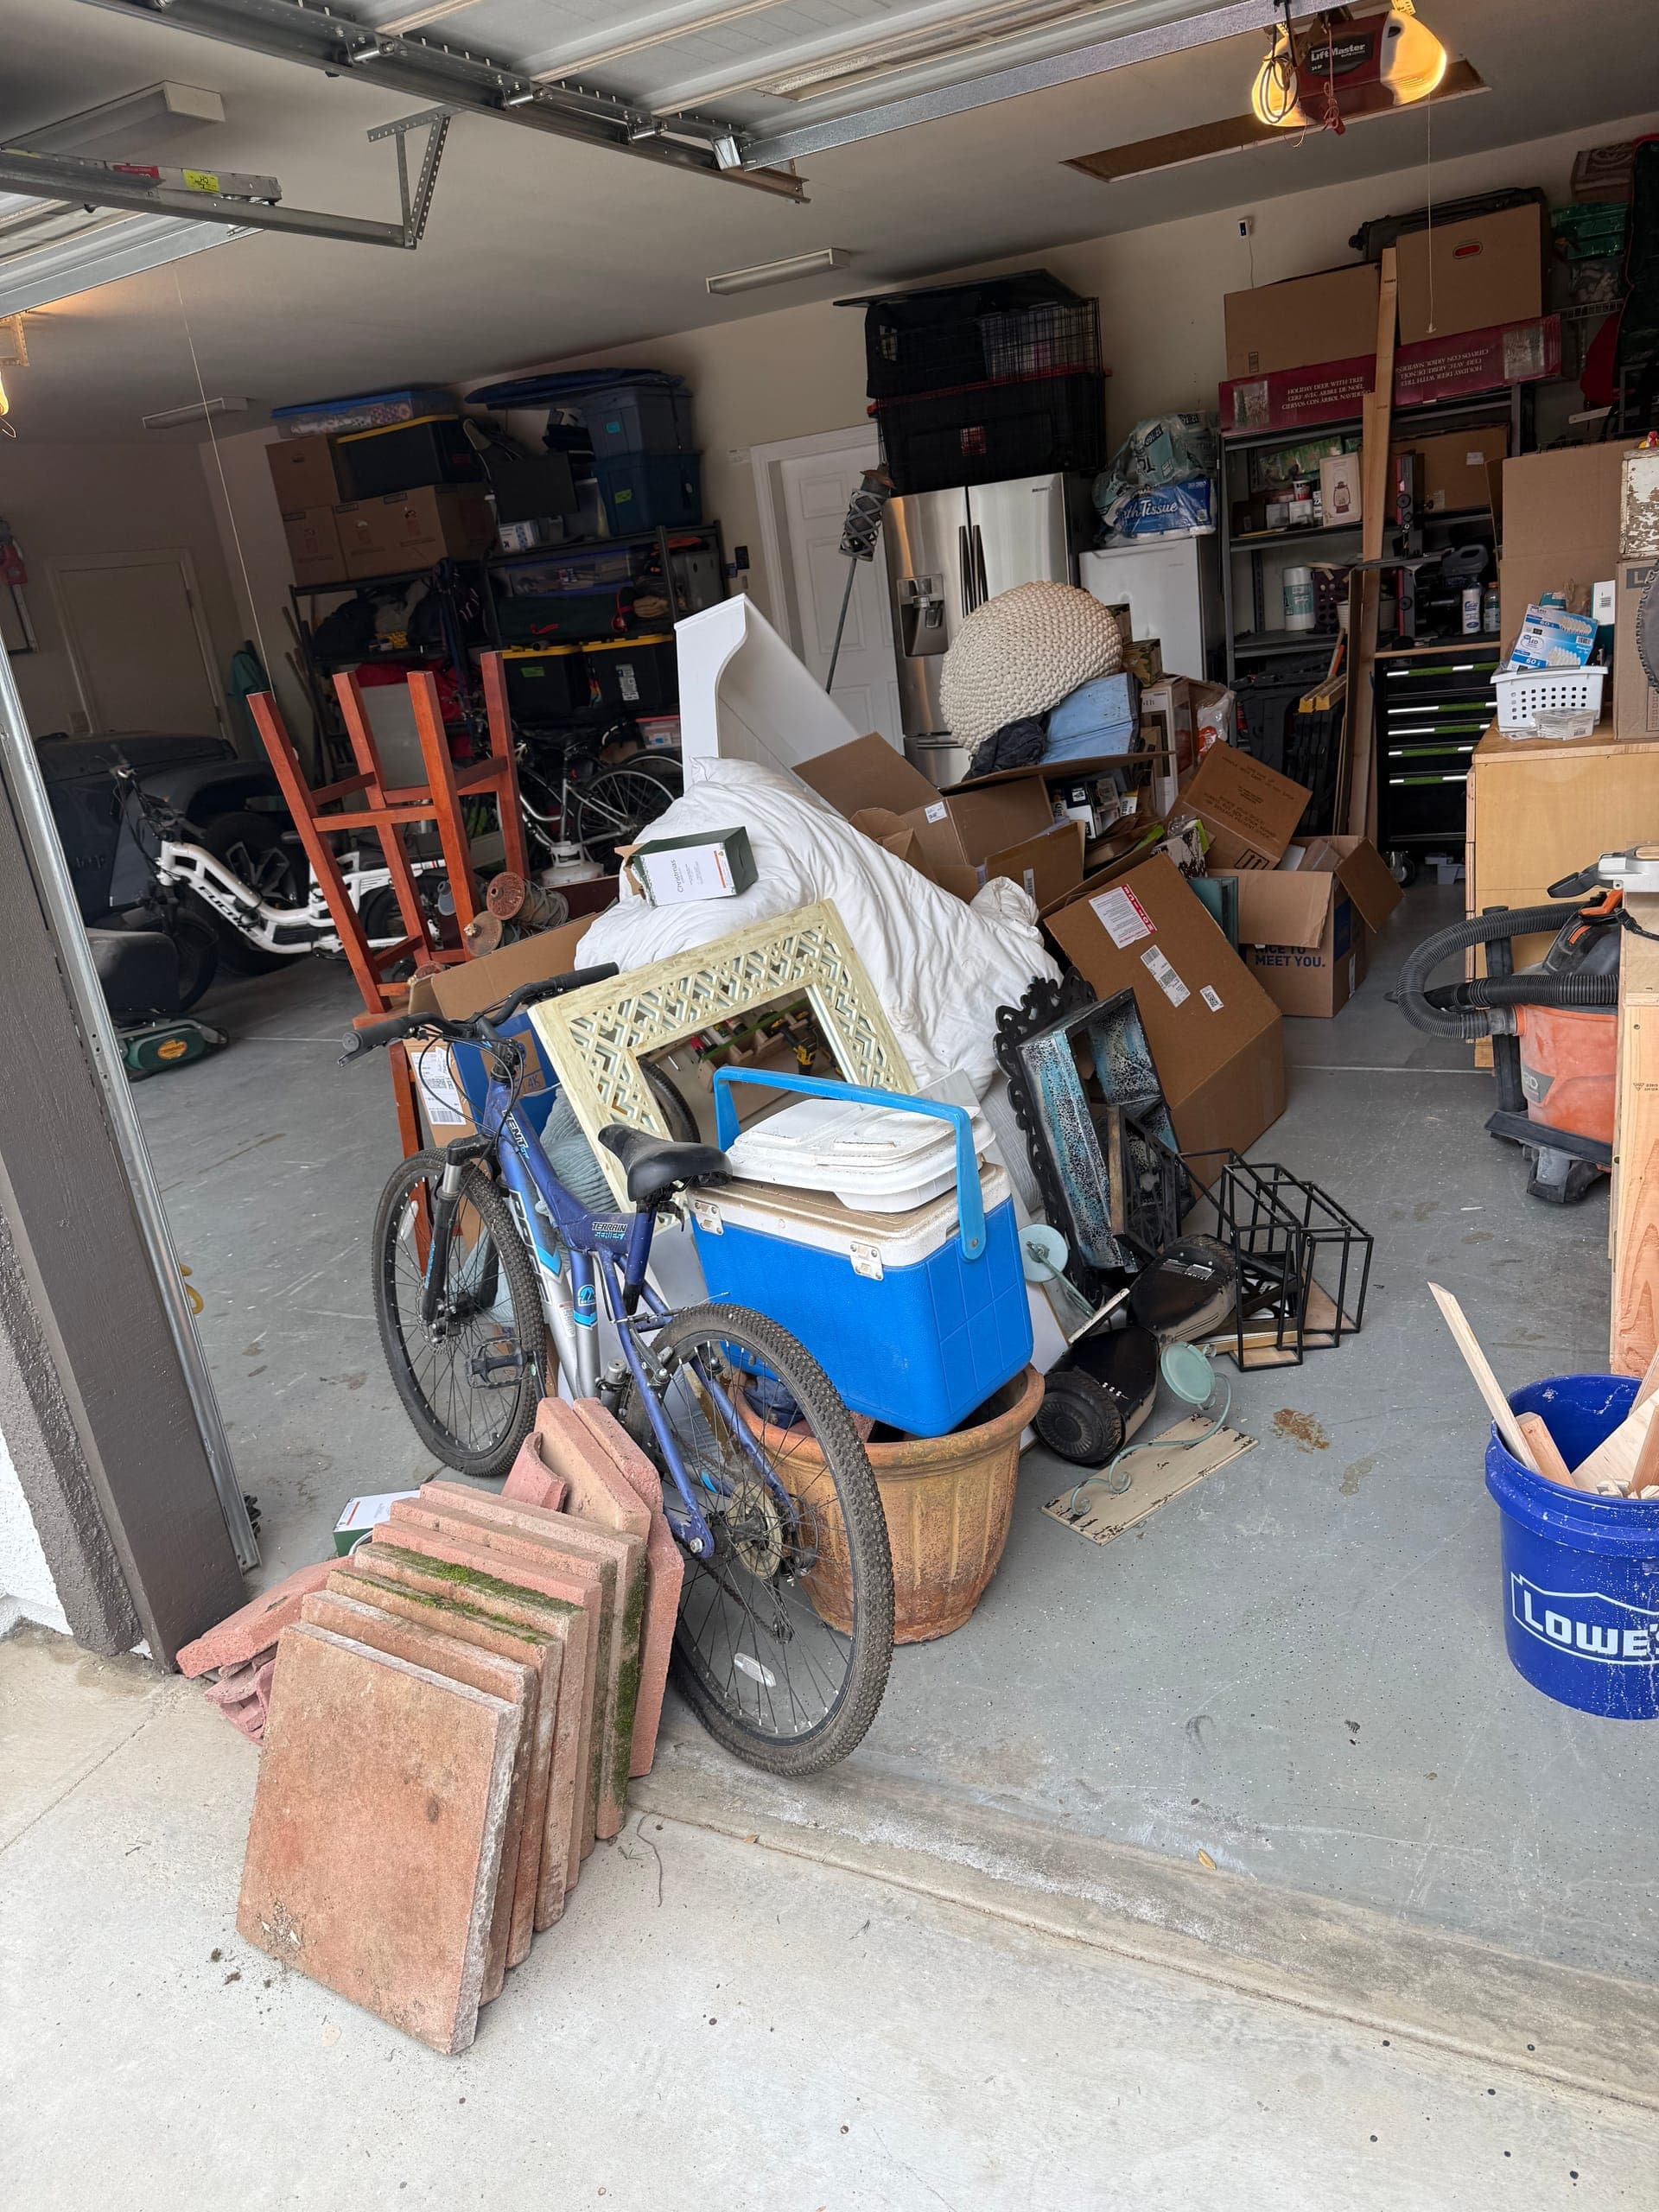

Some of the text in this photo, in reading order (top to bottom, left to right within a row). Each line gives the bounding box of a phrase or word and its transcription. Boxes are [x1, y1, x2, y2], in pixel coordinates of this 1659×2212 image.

[1140, 499, 1178, 518] Tissue
[671, 859, 683, 893] Christmas
[1255, 955, 1326, 967] MEET YOU.
[591, 1222, 628, 1232] TERRAIN
[1523, 1589, 1659, 1656] LOWE'
